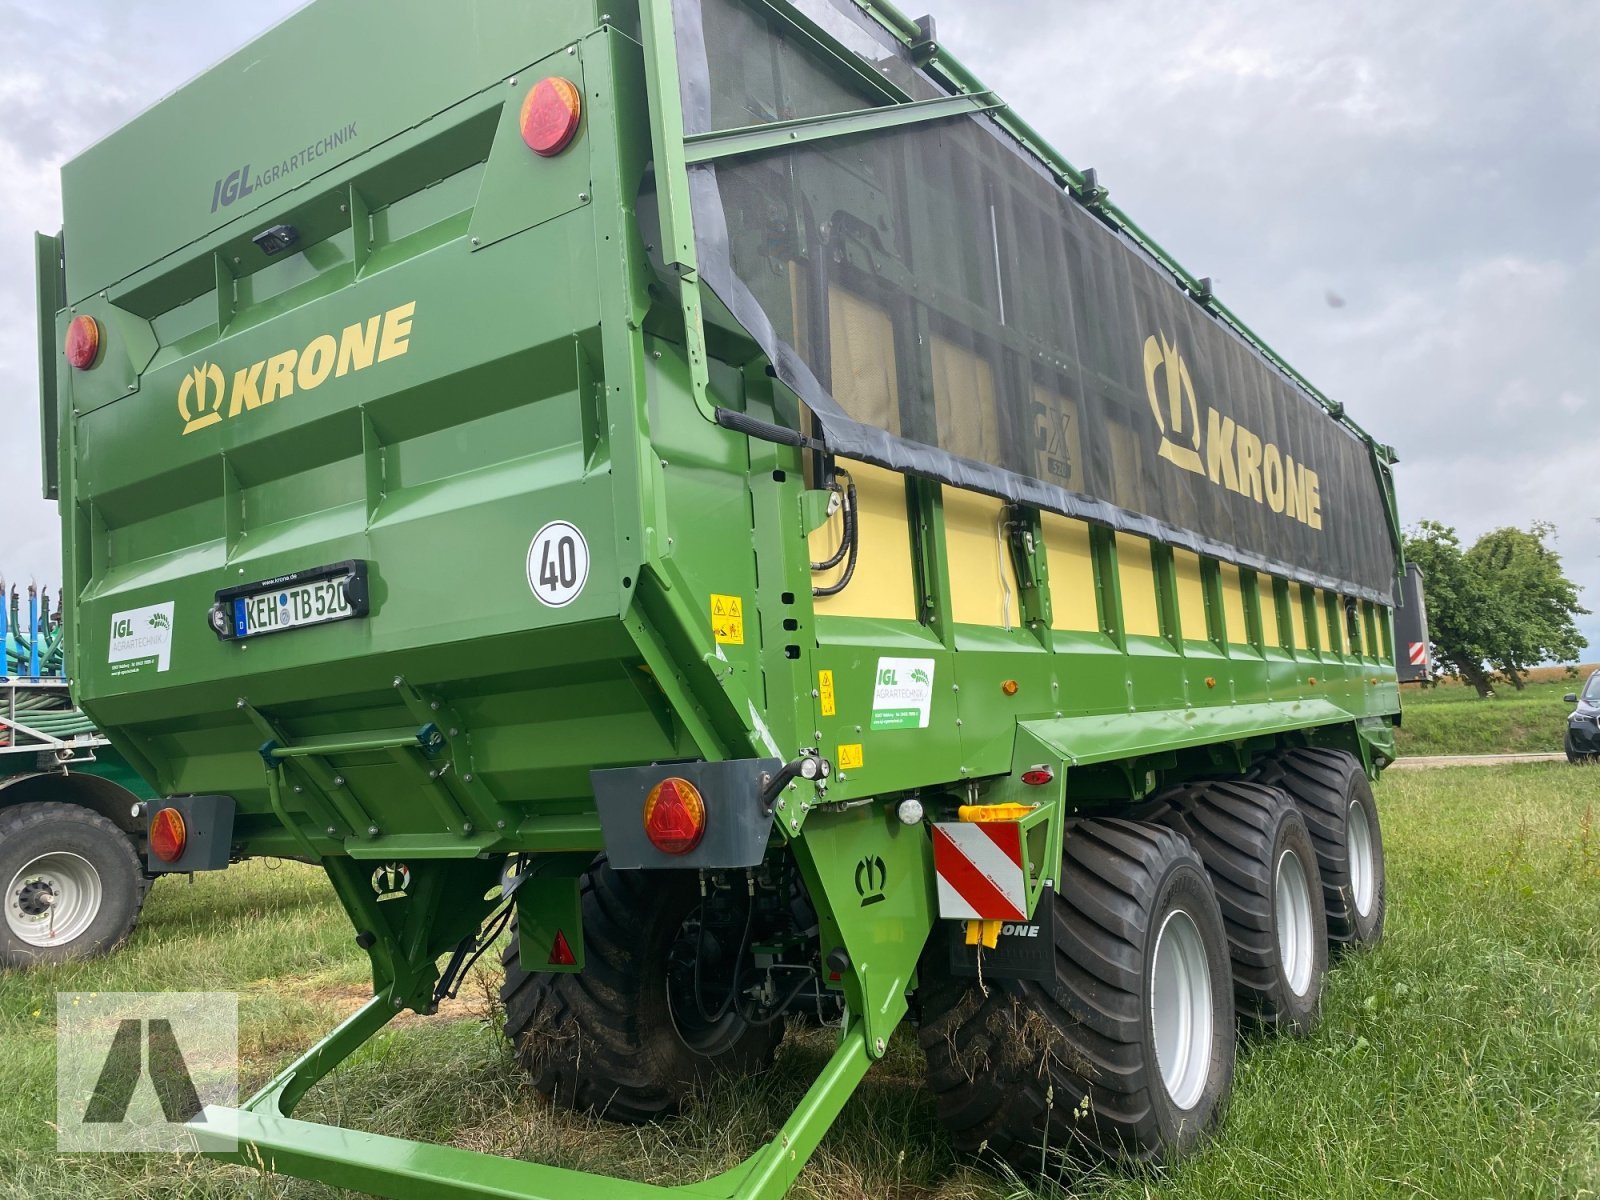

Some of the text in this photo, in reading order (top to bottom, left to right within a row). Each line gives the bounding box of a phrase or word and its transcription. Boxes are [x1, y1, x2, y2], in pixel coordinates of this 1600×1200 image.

[210, 121, 358, 214] IGL AGRARTECHNIK
[228, 300, 416, 418] KRONE
[1206, 406, 1322, 530] KRONE
[539, 535, 577, 592] 40
[261, 573, 298, 587] www.krone.de
[246, 580, 348, 631] KEH TB 520
[113, 619, 133, 639] IGL
[113, 634, 162, 651] AGRARTECHNIK
[878, 668, 898, 686] IGL
[876, 688, 923, 699] AGRARTECHNIK
[1002, 924, 1040, 937] ONE
